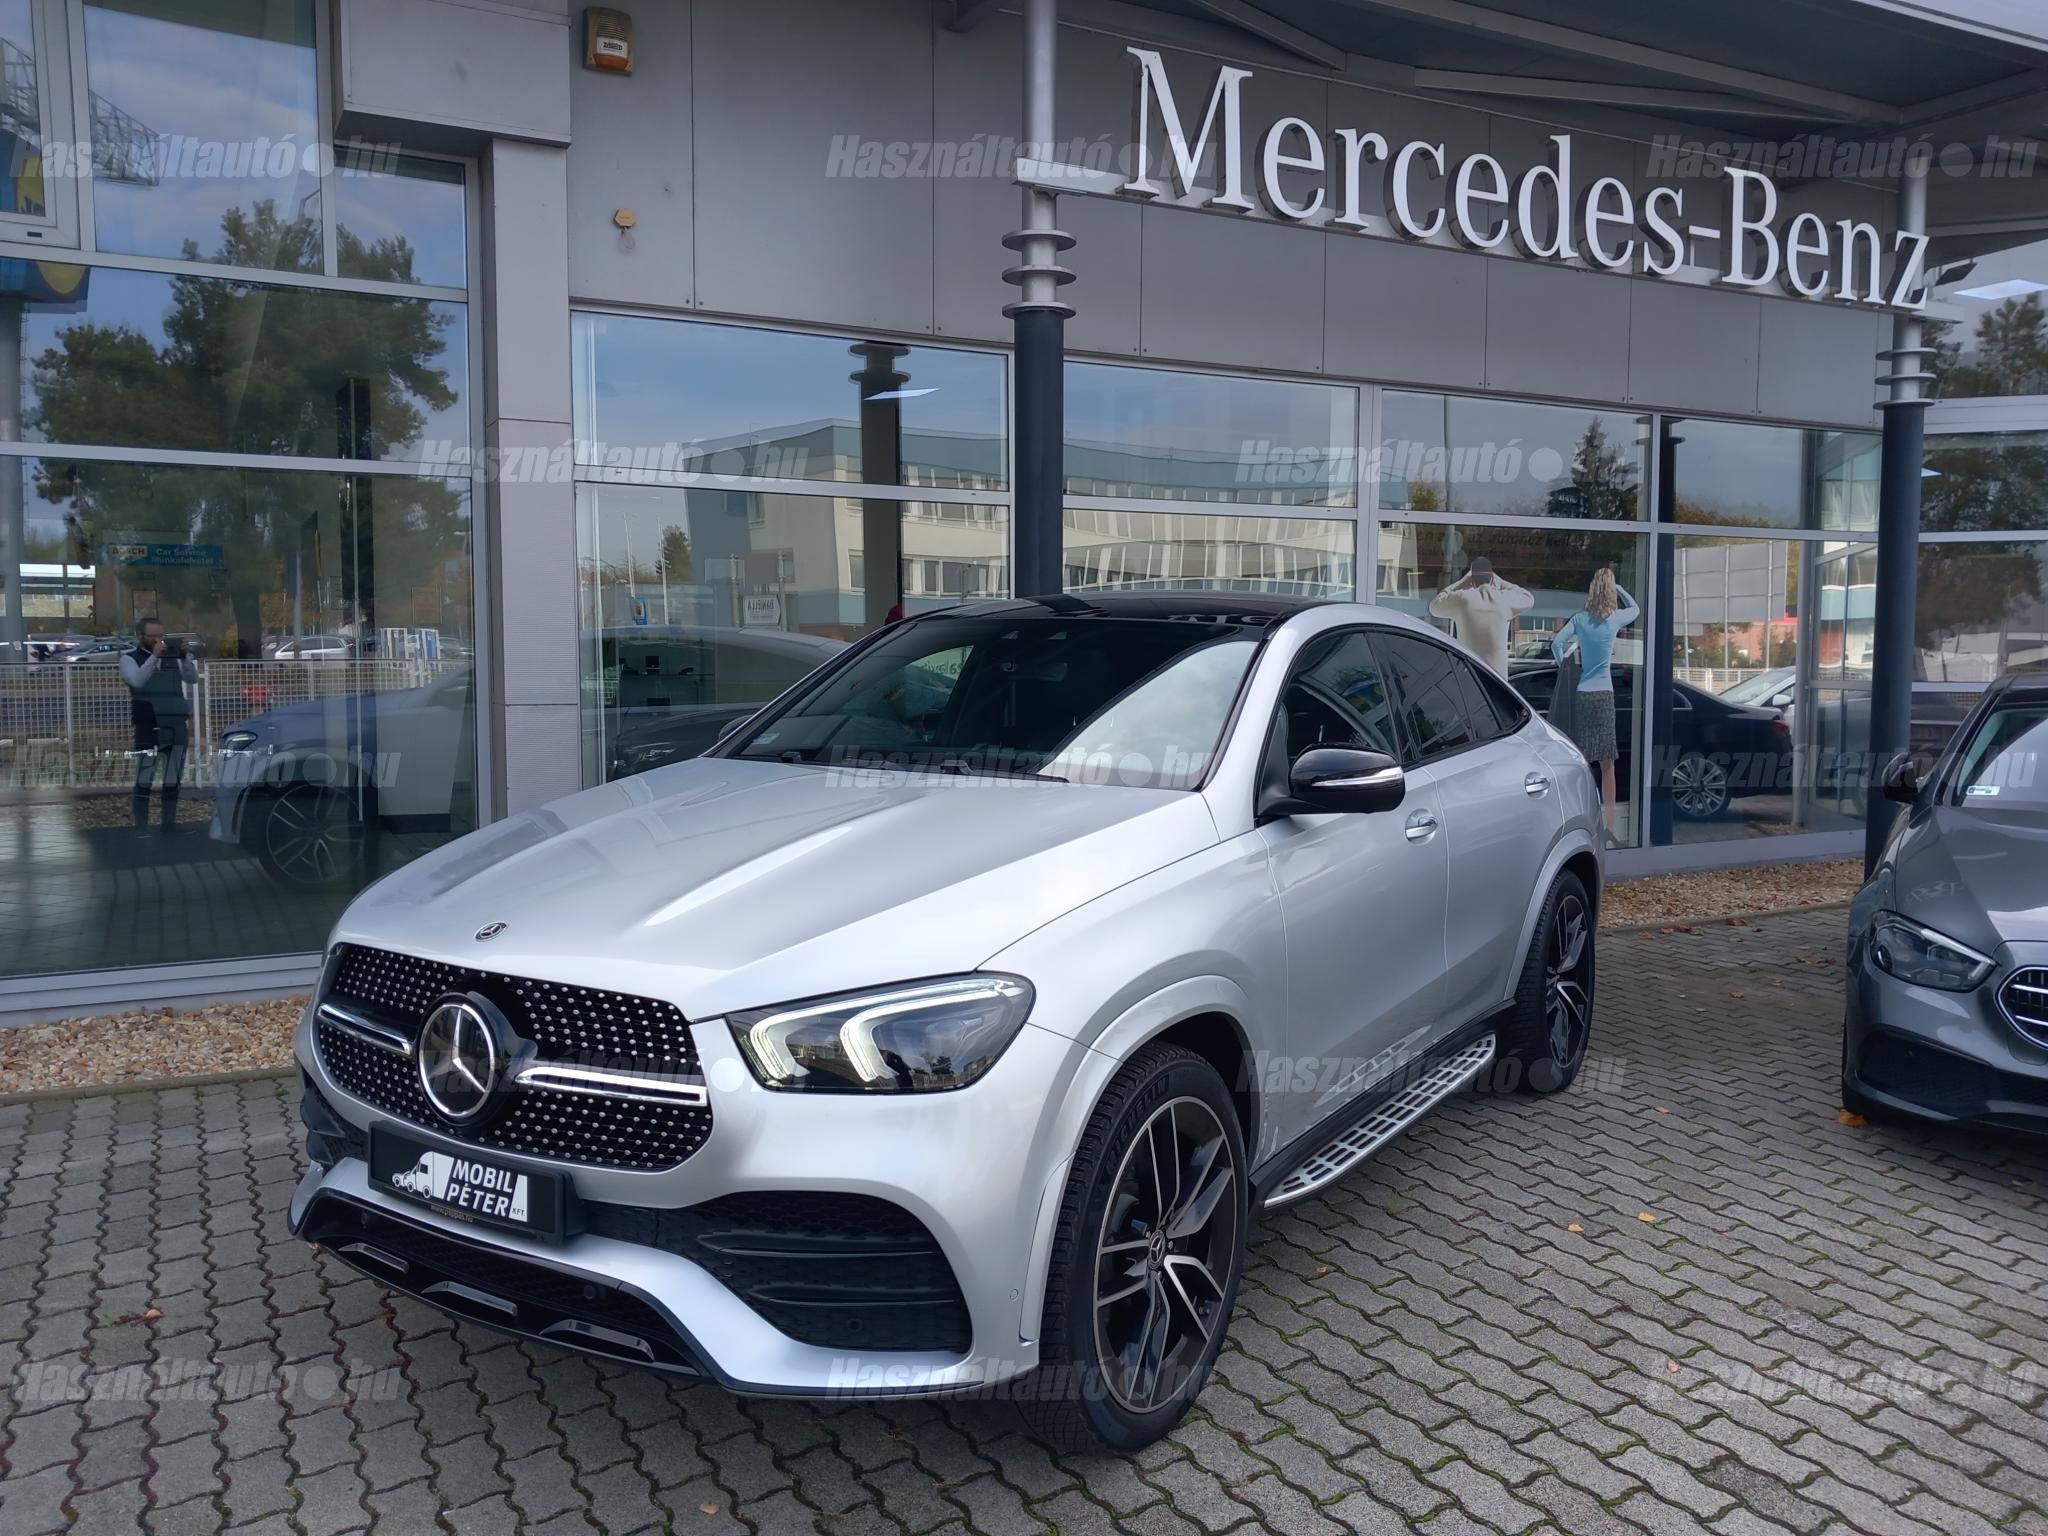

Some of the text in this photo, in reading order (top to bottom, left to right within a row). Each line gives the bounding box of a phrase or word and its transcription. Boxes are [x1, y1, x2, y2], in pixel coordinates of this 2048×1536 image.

[1124, 46, 1931, 311] Mercedes-Benz
[452, 1159, 513, 1193] MOBIL
[447, 1182, 509, 1217] PÉTER
